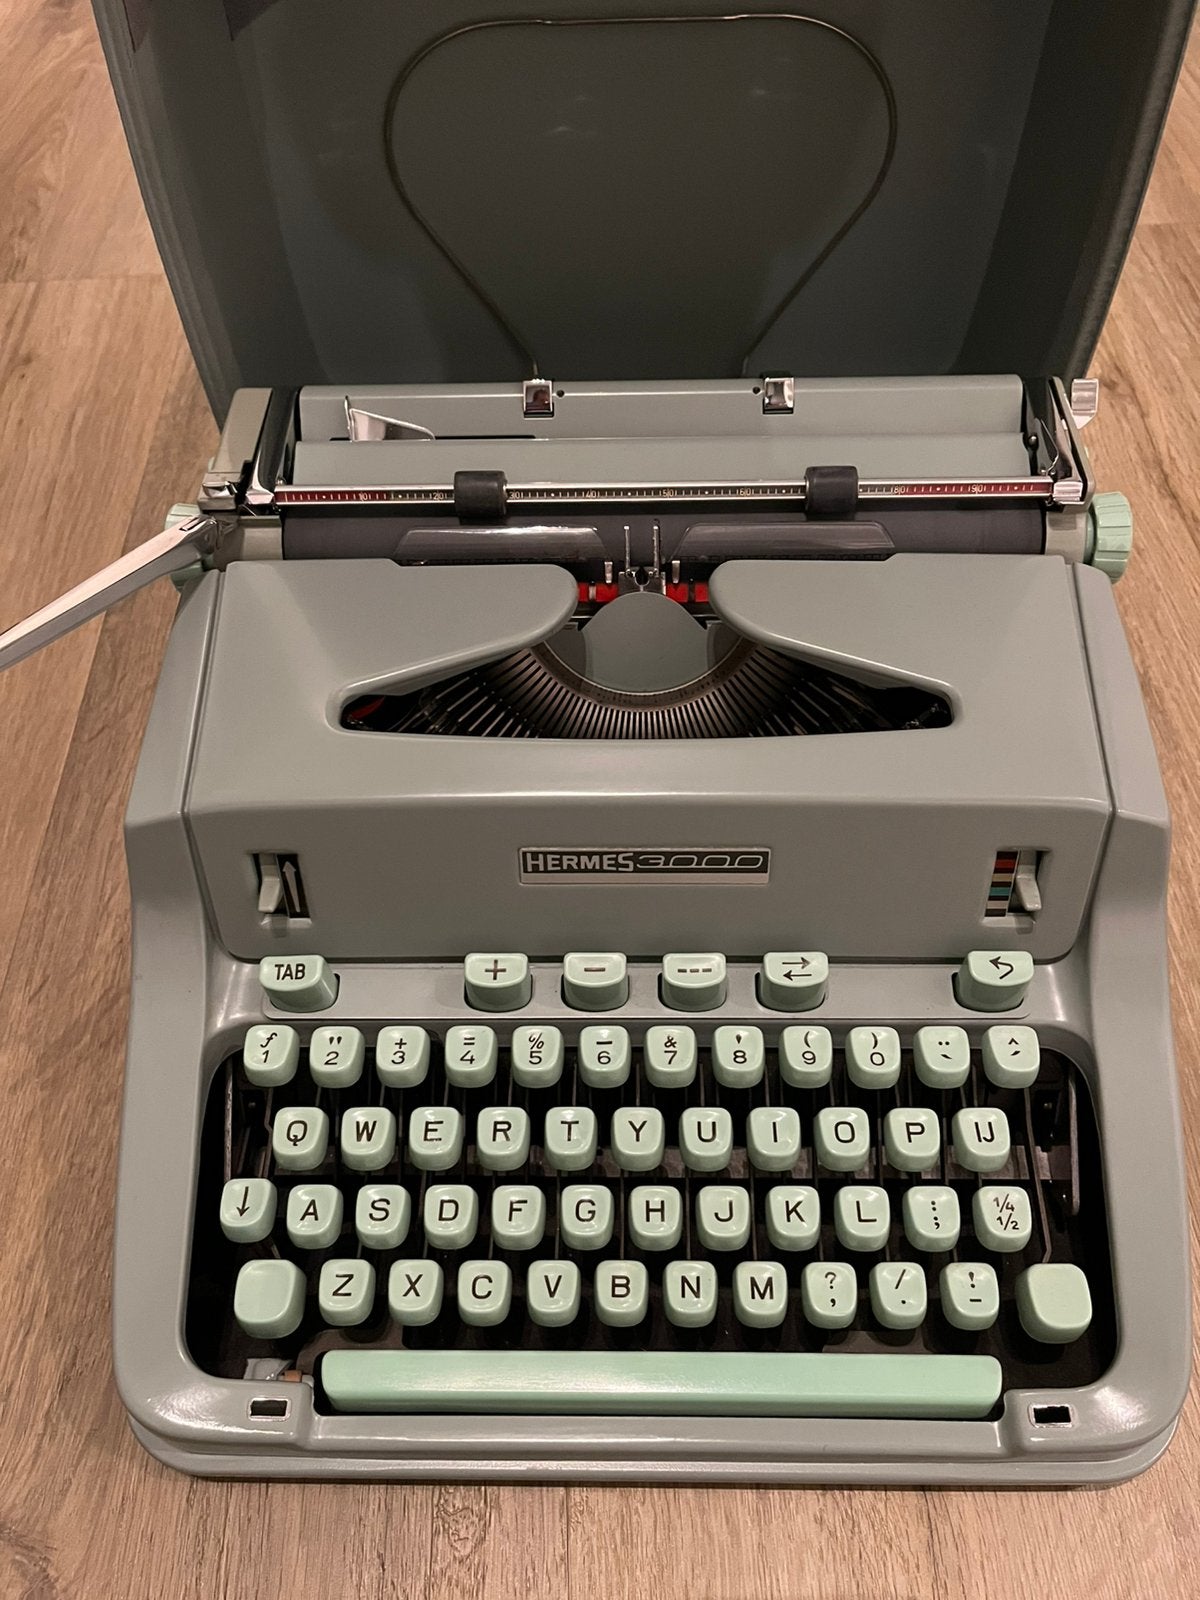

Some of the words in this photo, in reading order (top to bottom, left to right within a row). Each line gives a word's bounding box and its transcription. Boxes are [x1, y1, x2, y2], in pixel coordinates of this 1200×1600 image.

[358, 491, 368, 502] 10
[433, 491, 444, 501] 20
[509, 491, 520, 500] 30
[585, 490, 597, 499] 40
[662, 489, 674, 498] 50
[739, 488, 751, 496] 60
[893, 485, 906, 494] 80
[971, 484, 983, 493] 90
[526, 852, 634, 872] HERMES
[636, 854, 763, 869] 3000
[275, 964, 305, 980] TAB
[665, 1036, 676, 1048] &
[261, 1049, 272, 1065] 1
[324, 1051, 339, 1066] 2
[391, 1051, 406, 1065] 3
[460, 1051, 475, 1064] 4
[529, 1051, 543, 1065] 5
[598, 1051, 611, 1064] 6
[664, 1051, 677, 1064] 7
[734, 1050, 747, 1064] 8
[802, 1051, 815, 1064] 9
[287, 1121, 307, 1146] Q
[356, 1121, 376, 1141] W
[424, 1121, 443, 1141] E
[493, 1121, 511, 1141] R
[561, 1121, 579, 1141] T
[629, 1121, 647, 1142] Y
[698, 1121, 716, 1142] U
[772, 1121, 778, 1143] I
[835, 1121, 855, 1143] O
[906, 1123, 924, 1143] P
[300, 1200, 318, 1221] A
[369, 1199, 390, 1221] S
[439, 1200, 458, 1221] D
[509, 1200, 527, 1221] F
[576, 1200, 595, 1222] G
[646, 1200, 664, 1222] H
[715, 1201, 733, 1222] J
[786, 1201, 804, 1222] K
[856, 1201, 876, 1222] L
[333, 1274, 353, 1296] Z
[403, 1274, 422, 1296] X
[472, 1275, 492, 1299] C
[544, 1275, 562, 1297] V
[612, 1276, 630, 1297] B
[681, 1276, 700, 1298] N
[751, 1277, 773, 1299] M
[825, 1272, 836, 1289] ?
